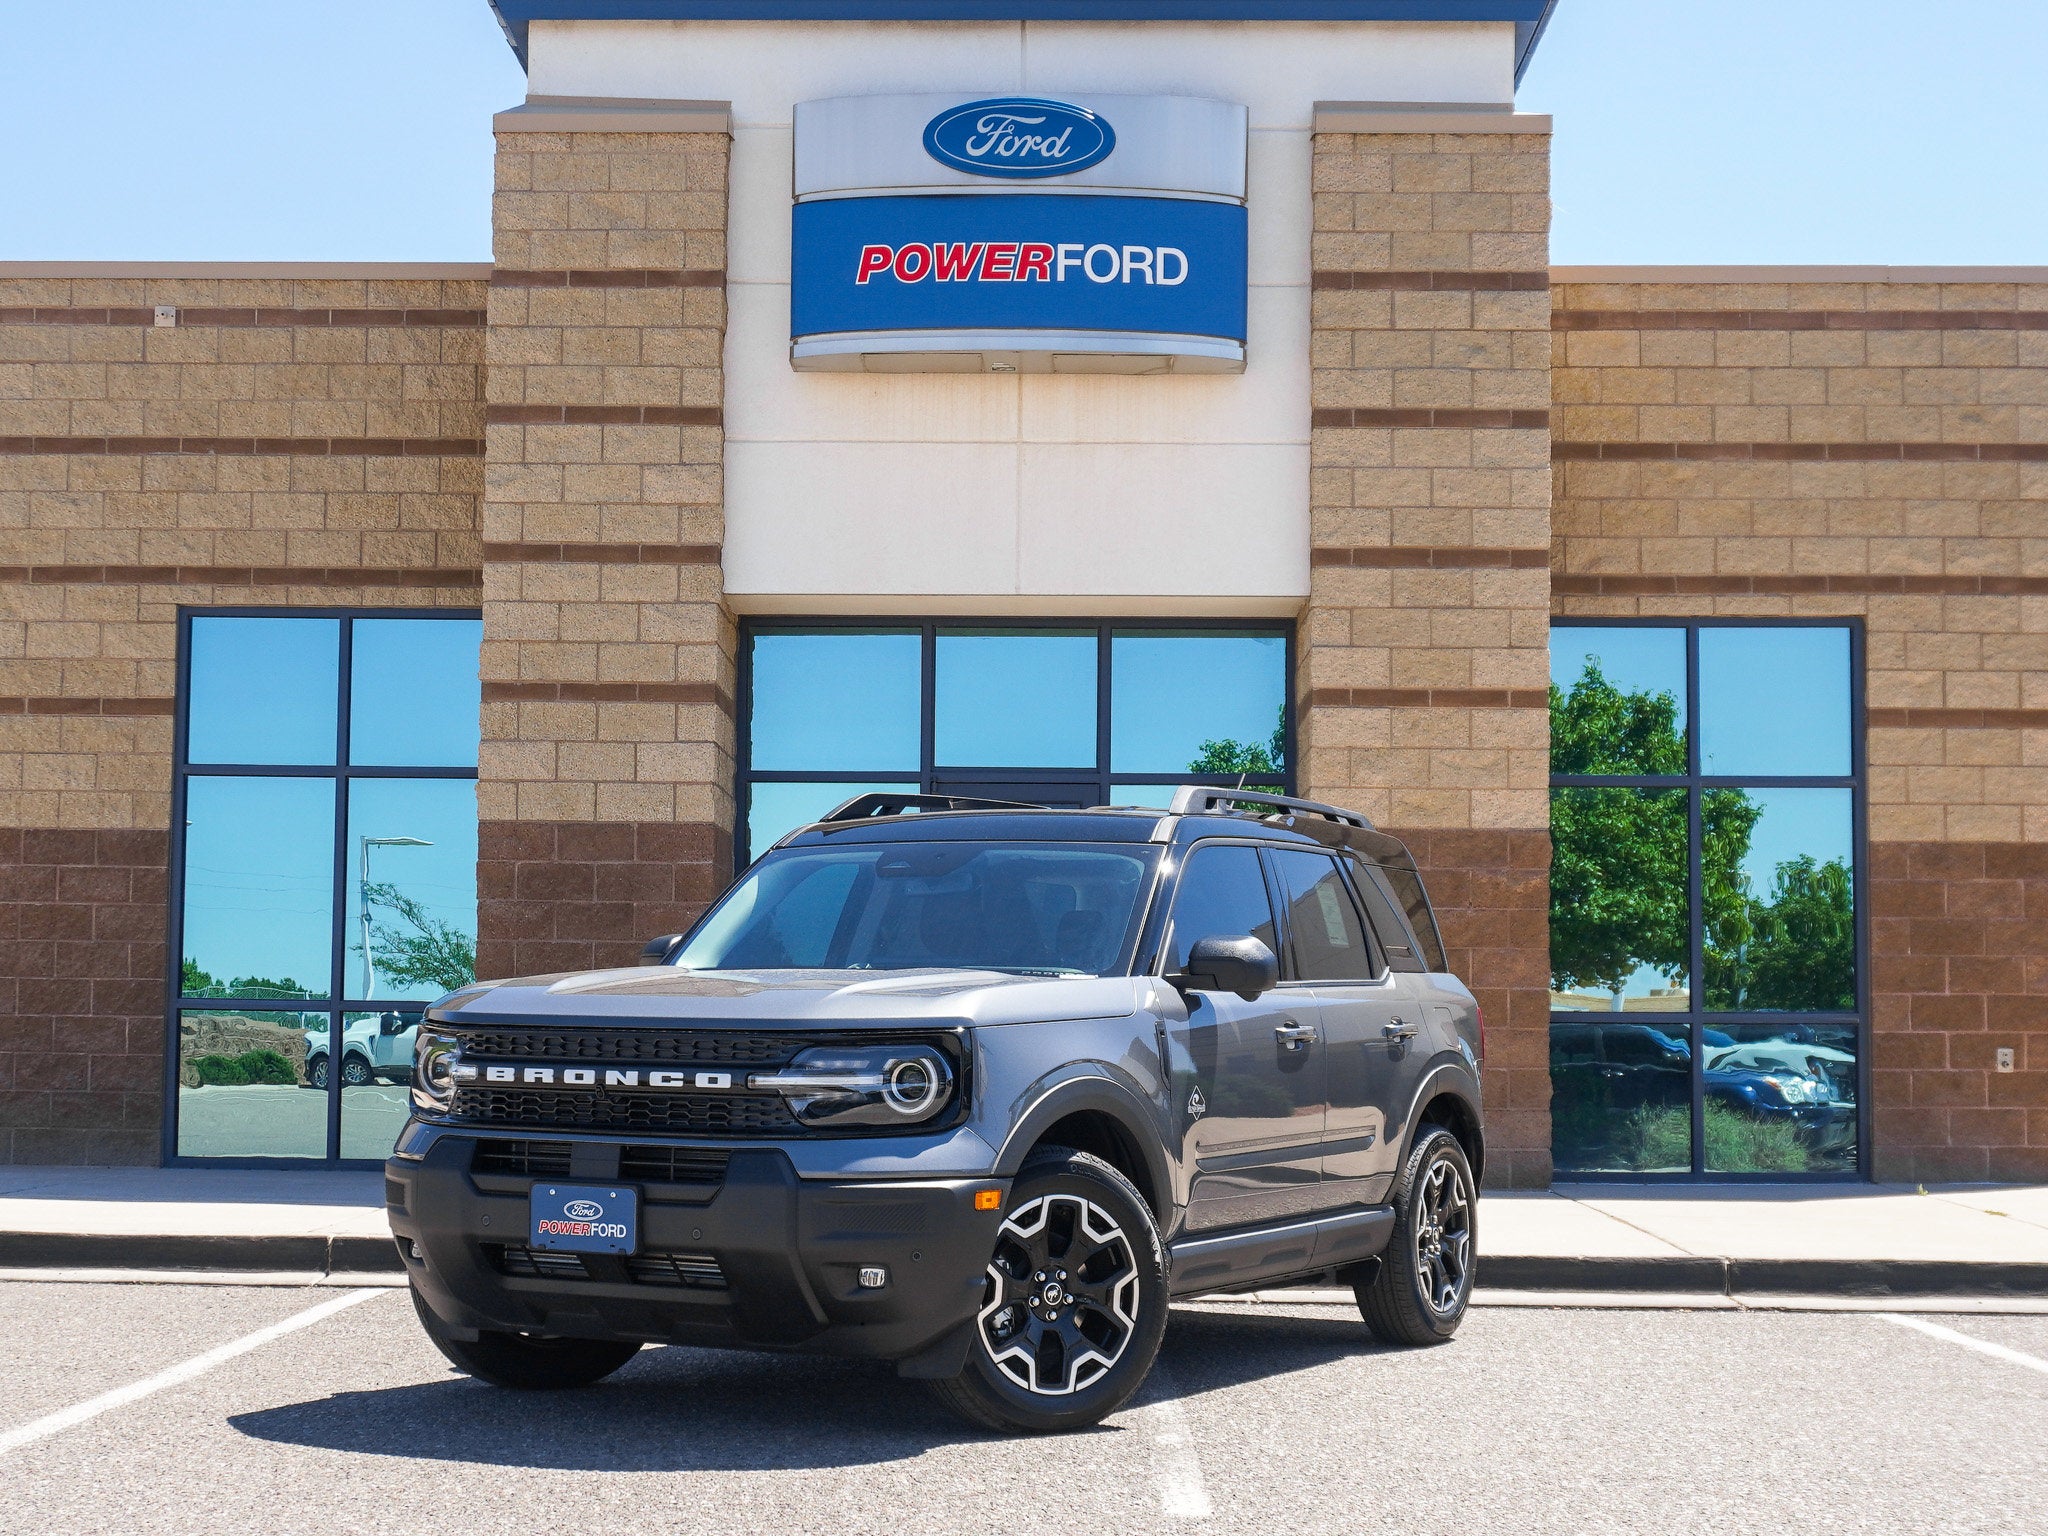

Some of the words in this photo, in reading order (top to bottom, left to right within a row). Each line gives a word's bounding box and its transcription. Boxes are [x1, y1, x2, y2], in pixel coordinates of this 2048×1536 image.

[965, 113, 1073, 158] Ford
[486, 1066, 731, 1089] BRONCO
[571, 1203, 596, 1217] Ford
